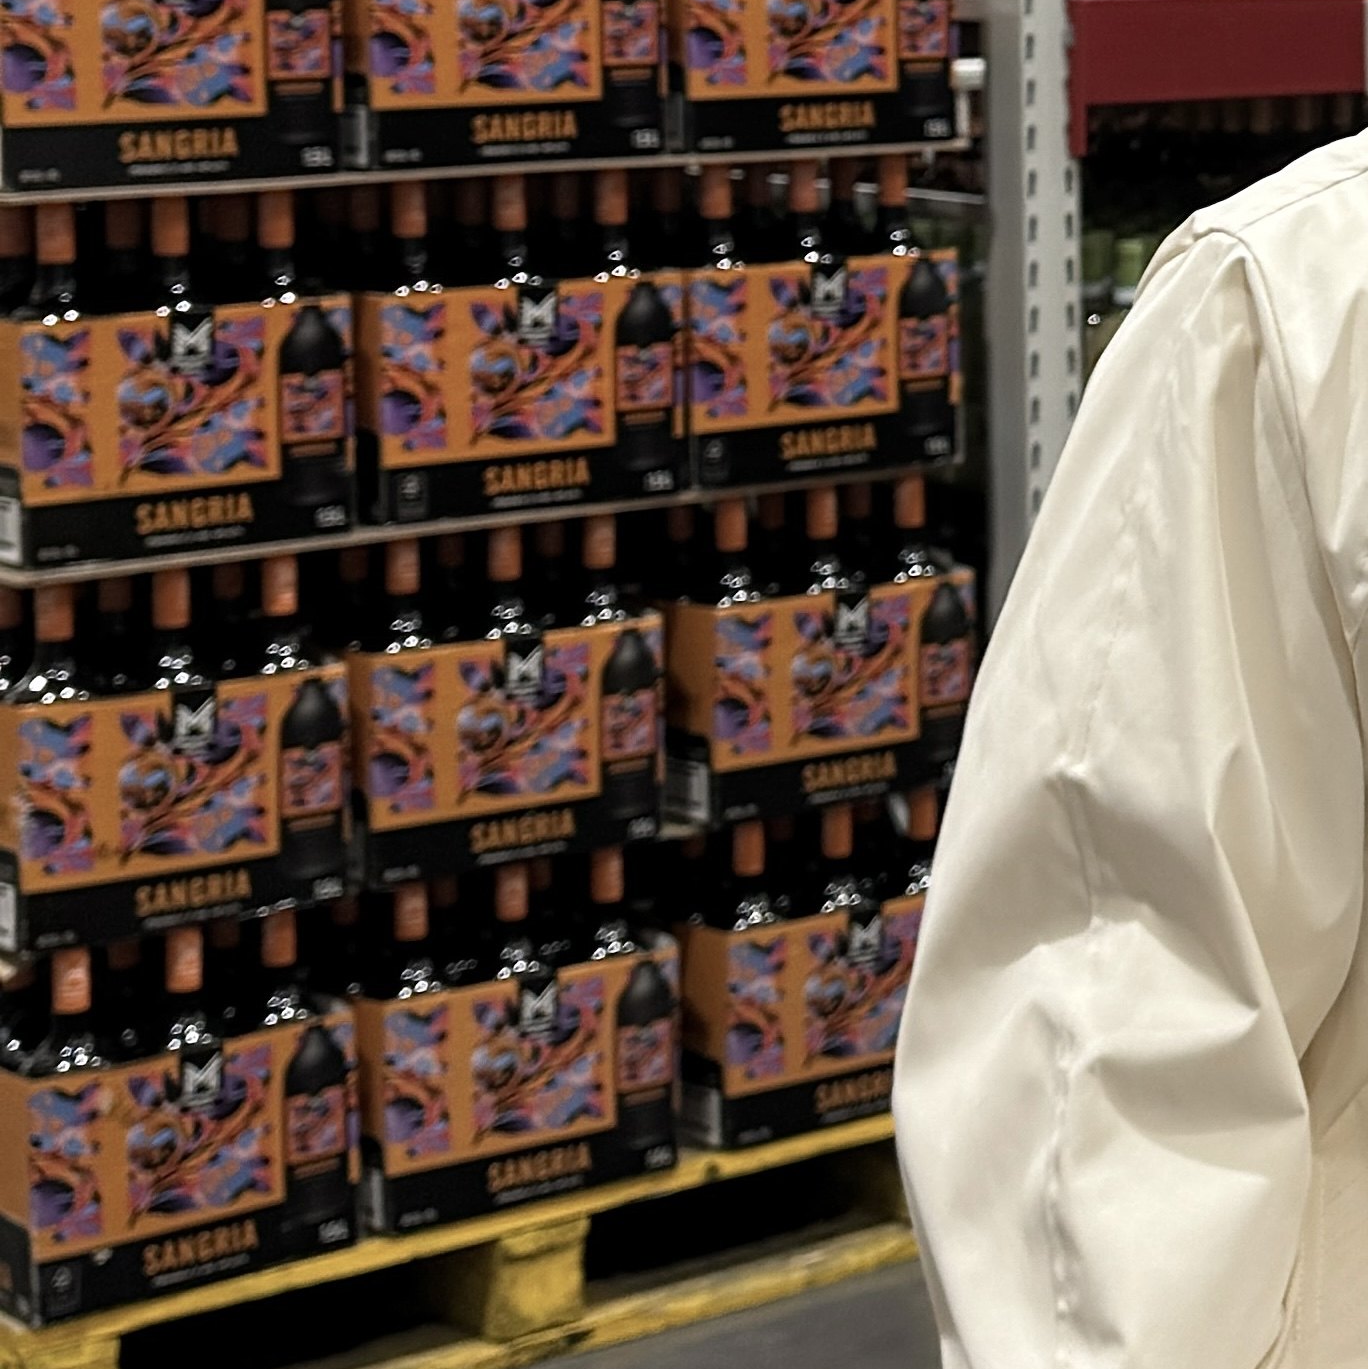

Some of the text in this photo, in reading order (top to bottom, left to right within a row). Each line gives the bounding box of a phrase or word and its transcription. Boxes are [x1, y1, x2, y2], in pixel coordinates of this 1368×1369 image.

[472, 110, 578, 144] SANGRIA
[778, 101, 875, 131] SANGRIA
[118, 128, 239, 163] SANGRIA
[780, 424, 876, 460] SANGRIA
[482, 457, 591, 495] SANGRIA
[134, 493, 254, 535] SANGRIA
[134, 870, 252, 917] SANGRIA
[142, 1219, 258, 1276] SANGRIA
